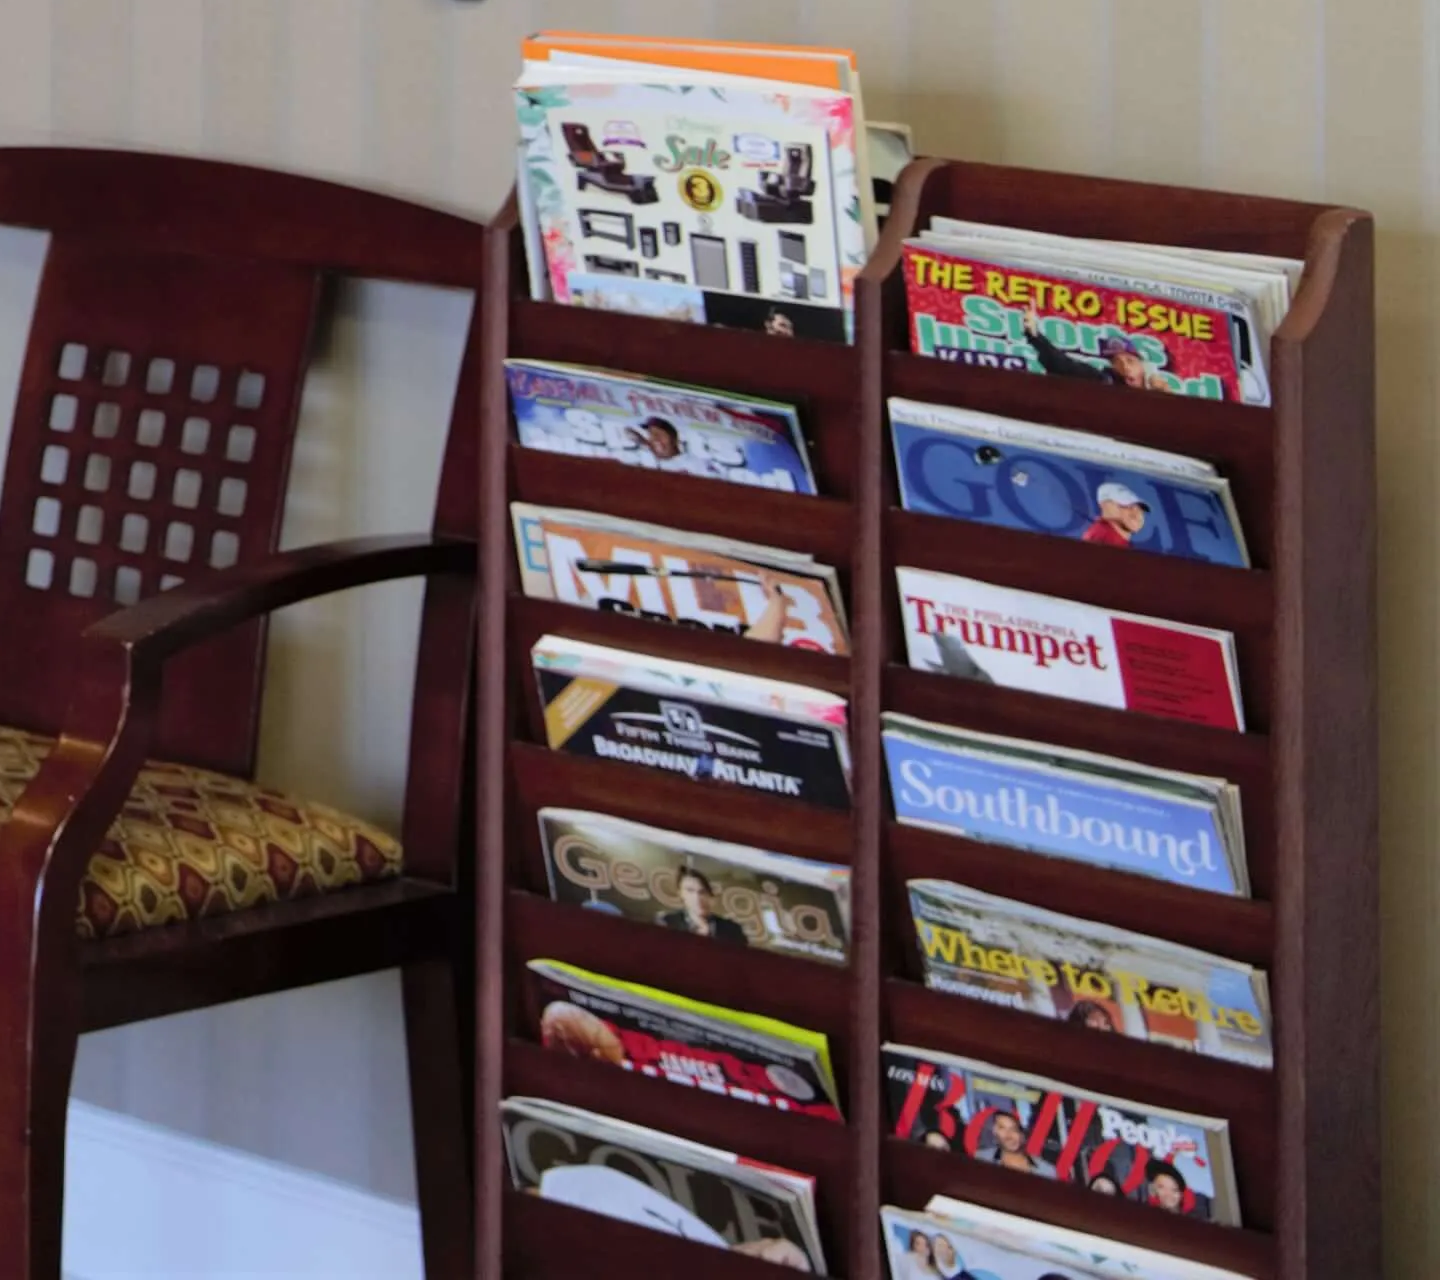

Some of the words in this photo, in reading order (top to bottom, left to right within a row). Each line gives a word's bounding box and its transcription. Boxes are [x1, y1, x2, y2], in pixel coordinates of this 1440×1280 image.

[652, 134, 731, 173] Sale
[909, 253, 976, 292] THE
[984, 270, 1101, 318] RETRO
[1116, 296, 1214, 340] ISSUE
[543, 531, 837, 656] MLB
[906, 595, 1108, 671] Trumpet
[943, 602, 971, 619] THE
[973, 608, 1077, 638] PHILADELPHIA
[899, 758, 1218, 877] Southbound
[914, 917, 1058, 987] Where
[1062, 960, 1113, 1000] to
[1116, 968, 1263, 1036] Retire
